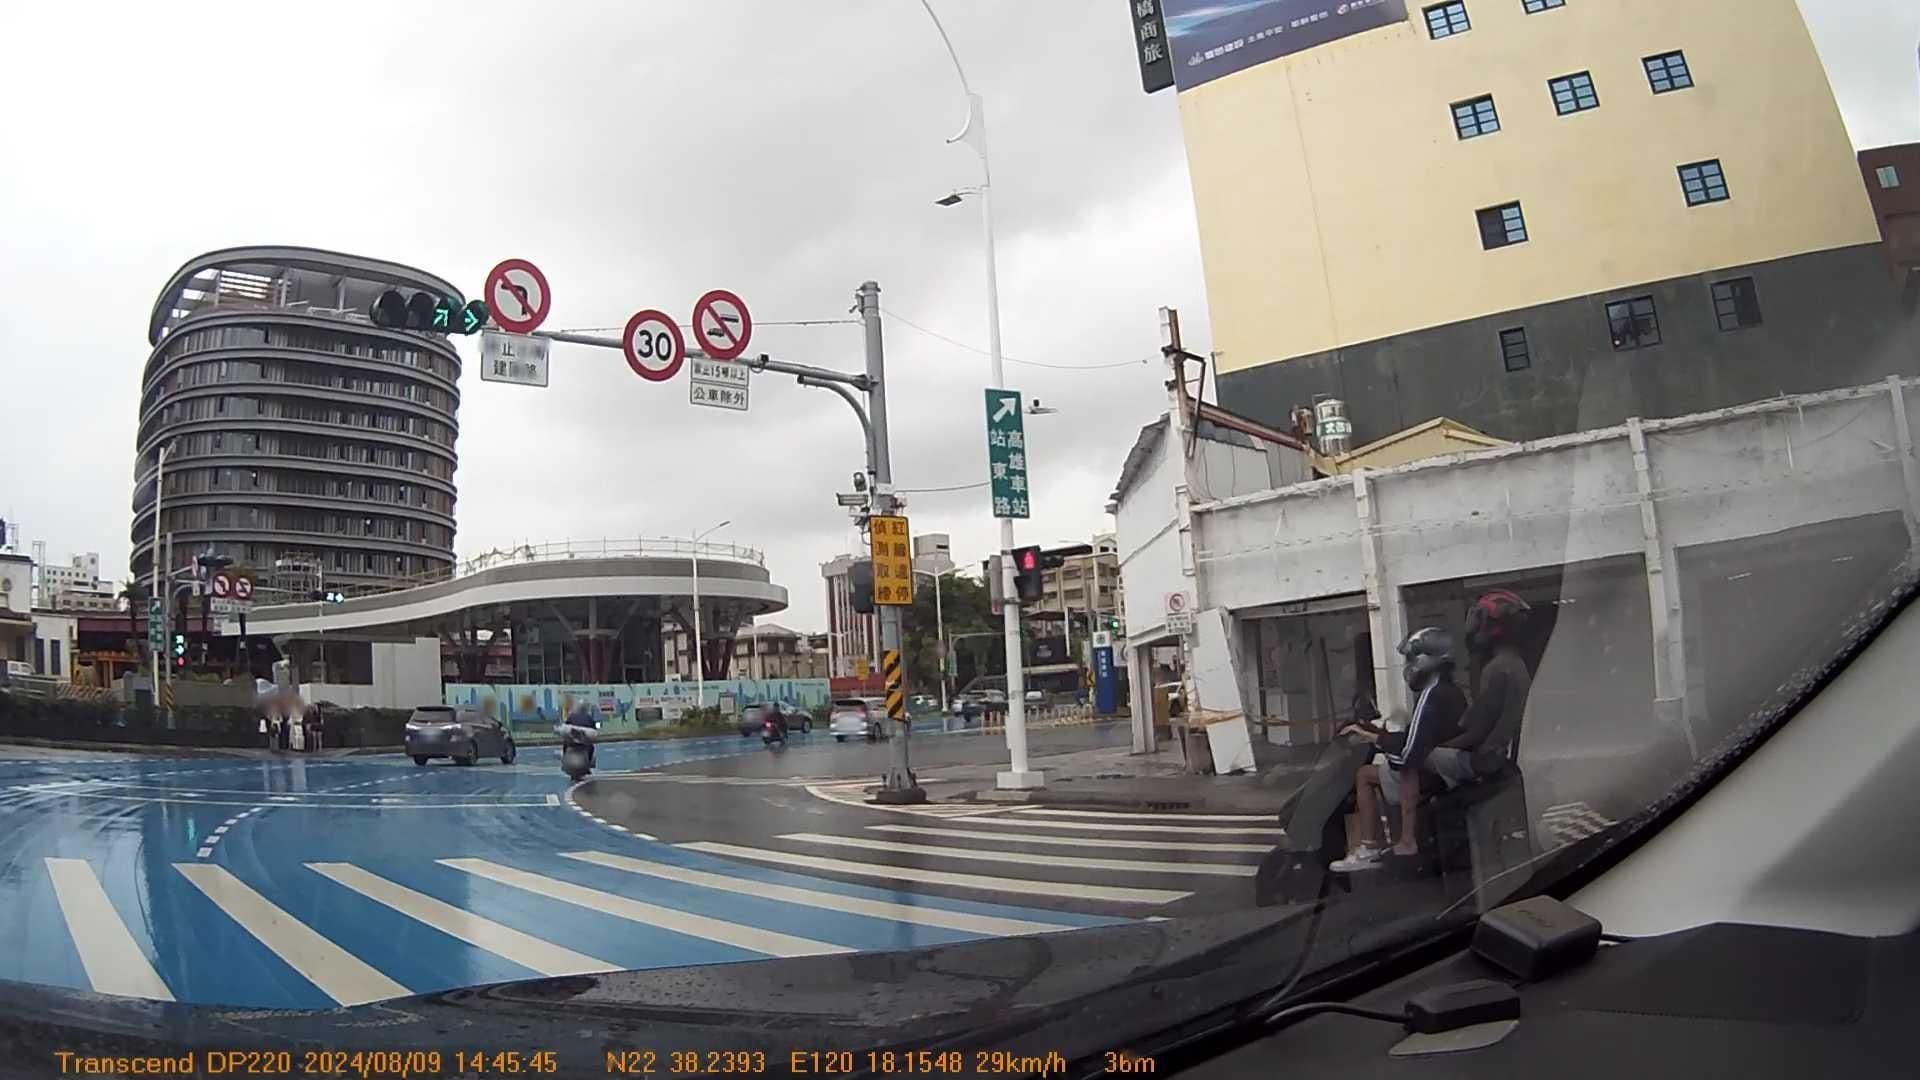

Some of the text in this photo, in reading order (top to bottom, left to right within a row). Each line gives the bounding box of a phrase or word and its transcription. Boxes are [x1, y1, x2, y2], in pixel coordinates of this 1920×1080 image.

[638, 330, 672, 361] 30
[694, 386, 744, 405] 公車除外
[991, 429, 1011, 514] 站東路
[1008, 430, 1028, 515] 高雄車站
